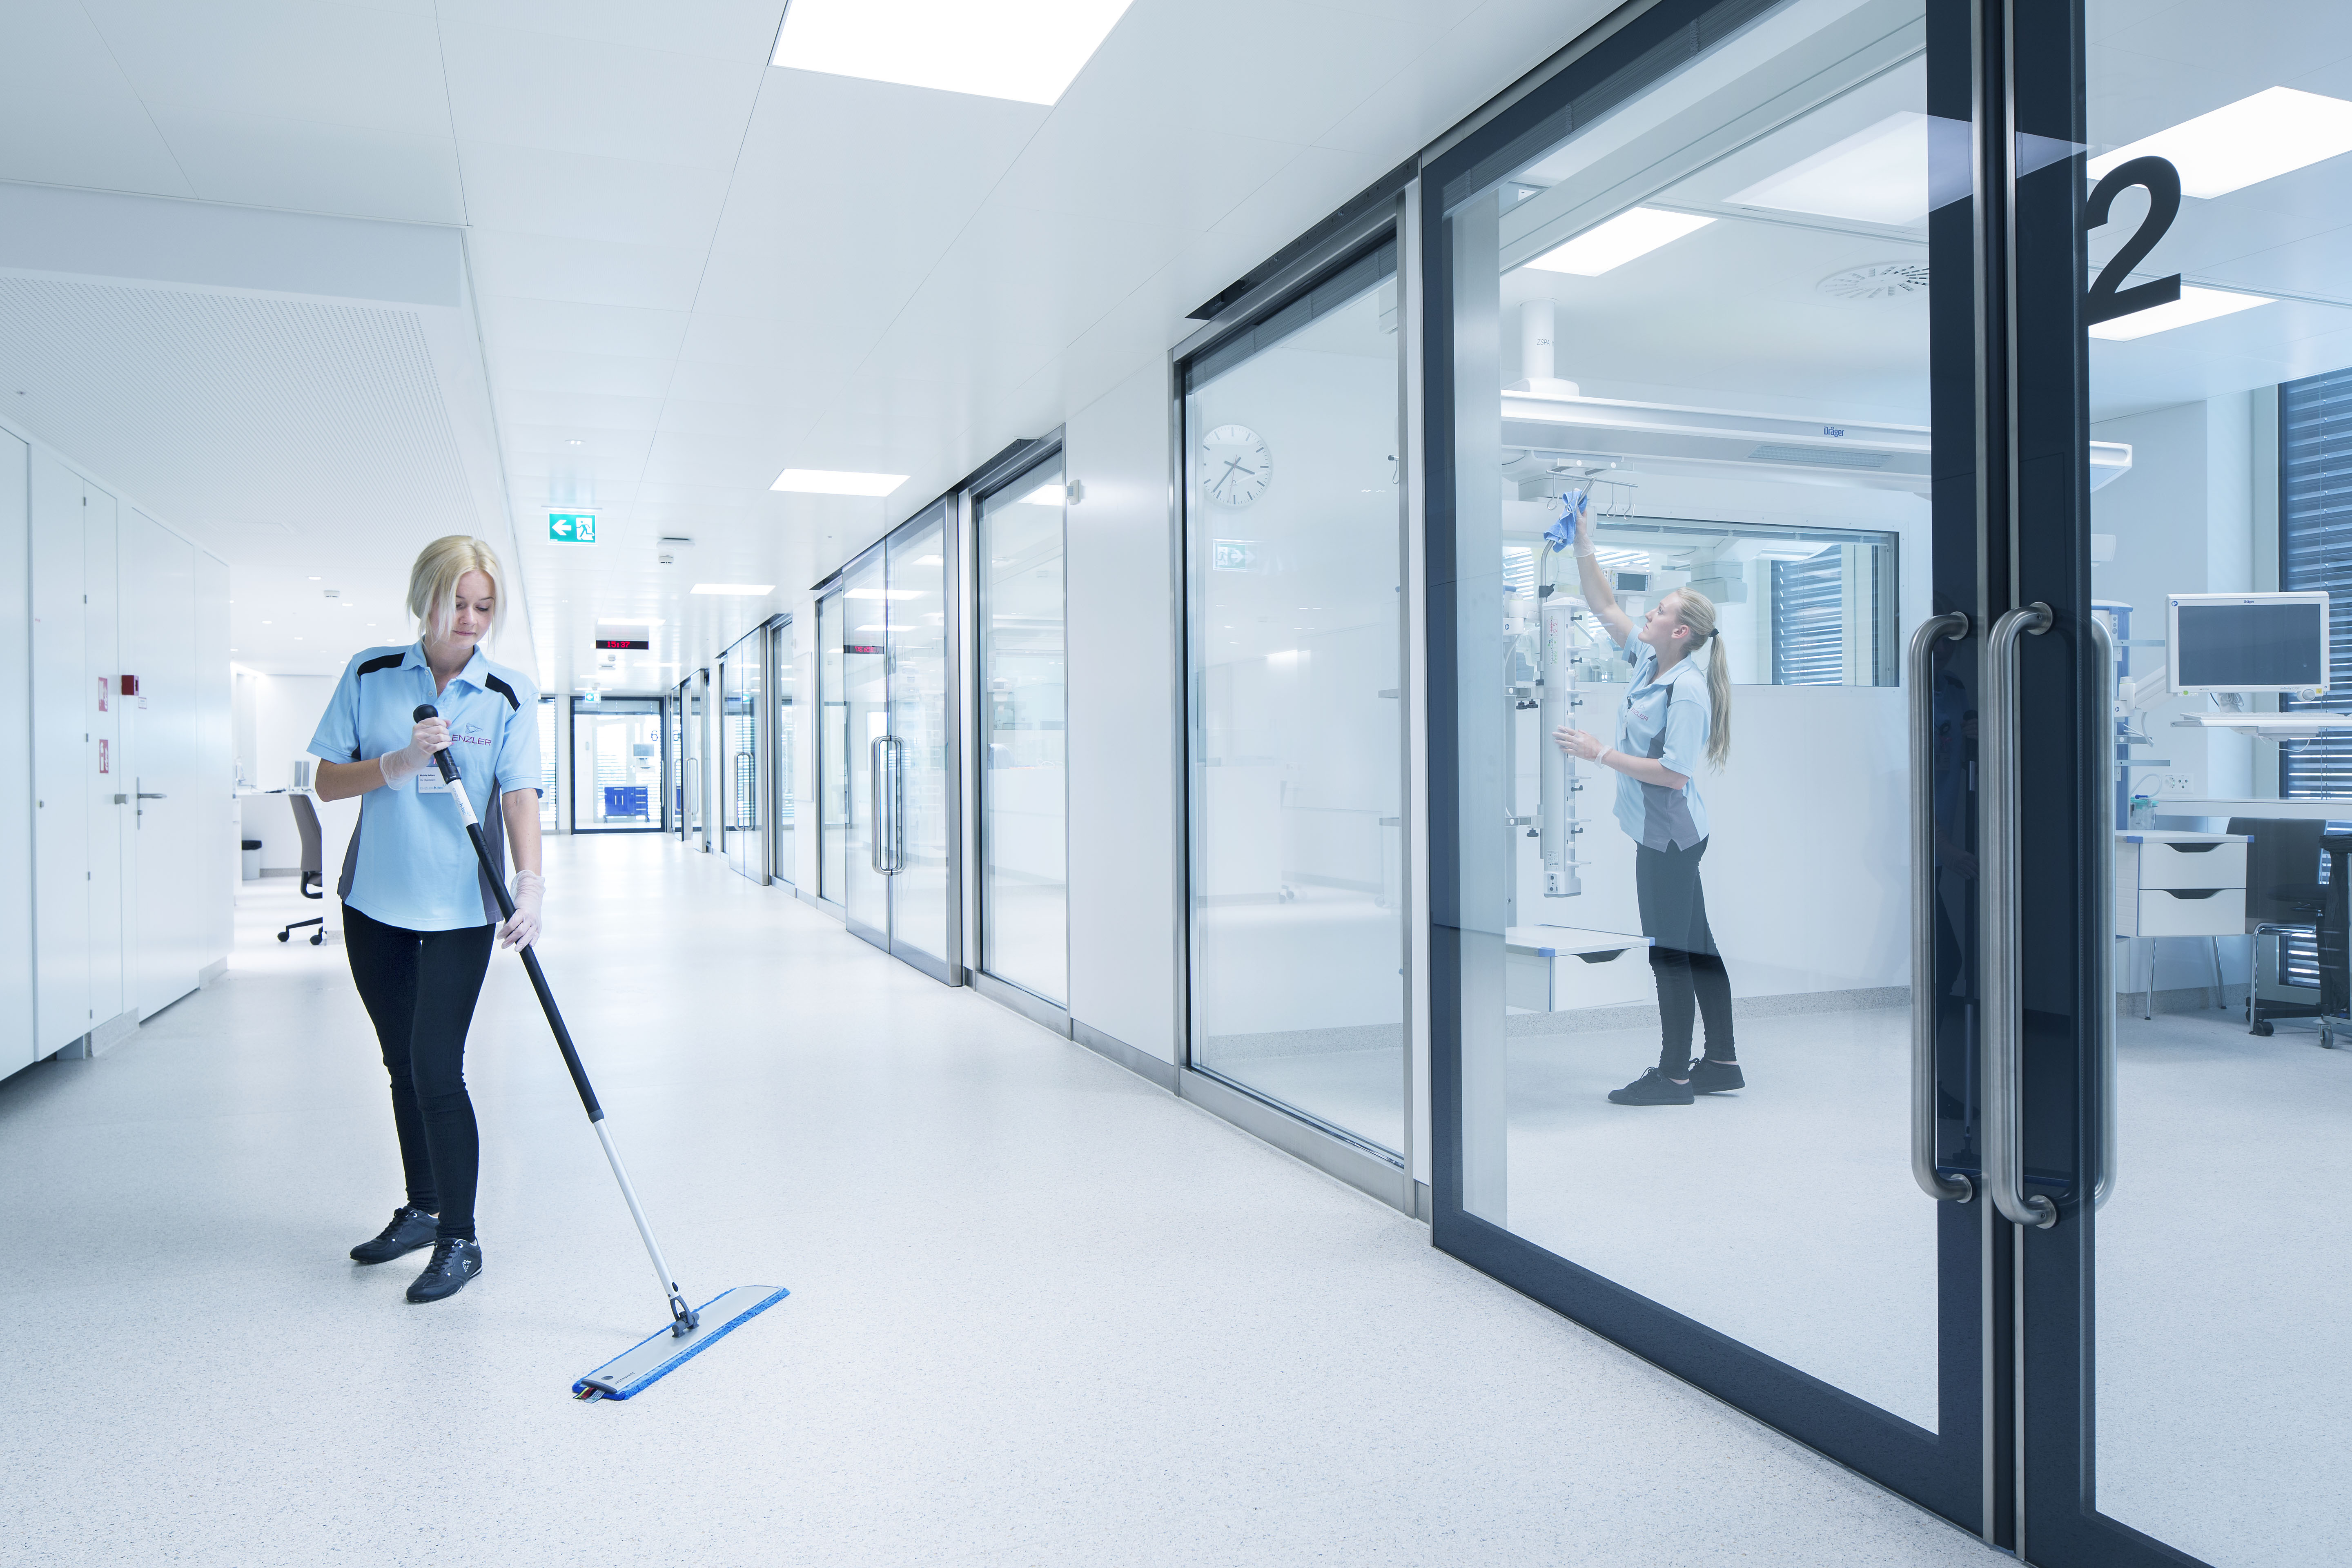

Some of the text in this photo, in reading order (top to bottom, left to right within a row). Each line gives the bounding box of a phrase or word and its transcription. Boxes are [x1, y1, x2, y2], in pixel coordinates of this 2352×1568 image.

[2083, 156, 2181, 326] 2
[1824, 426, 1844, 437] Dräger
[1630, 707, 1648, 722] ENZLER
[452, 735, 492, 746] ENZLER
[651, 730, 658, 741] 6
